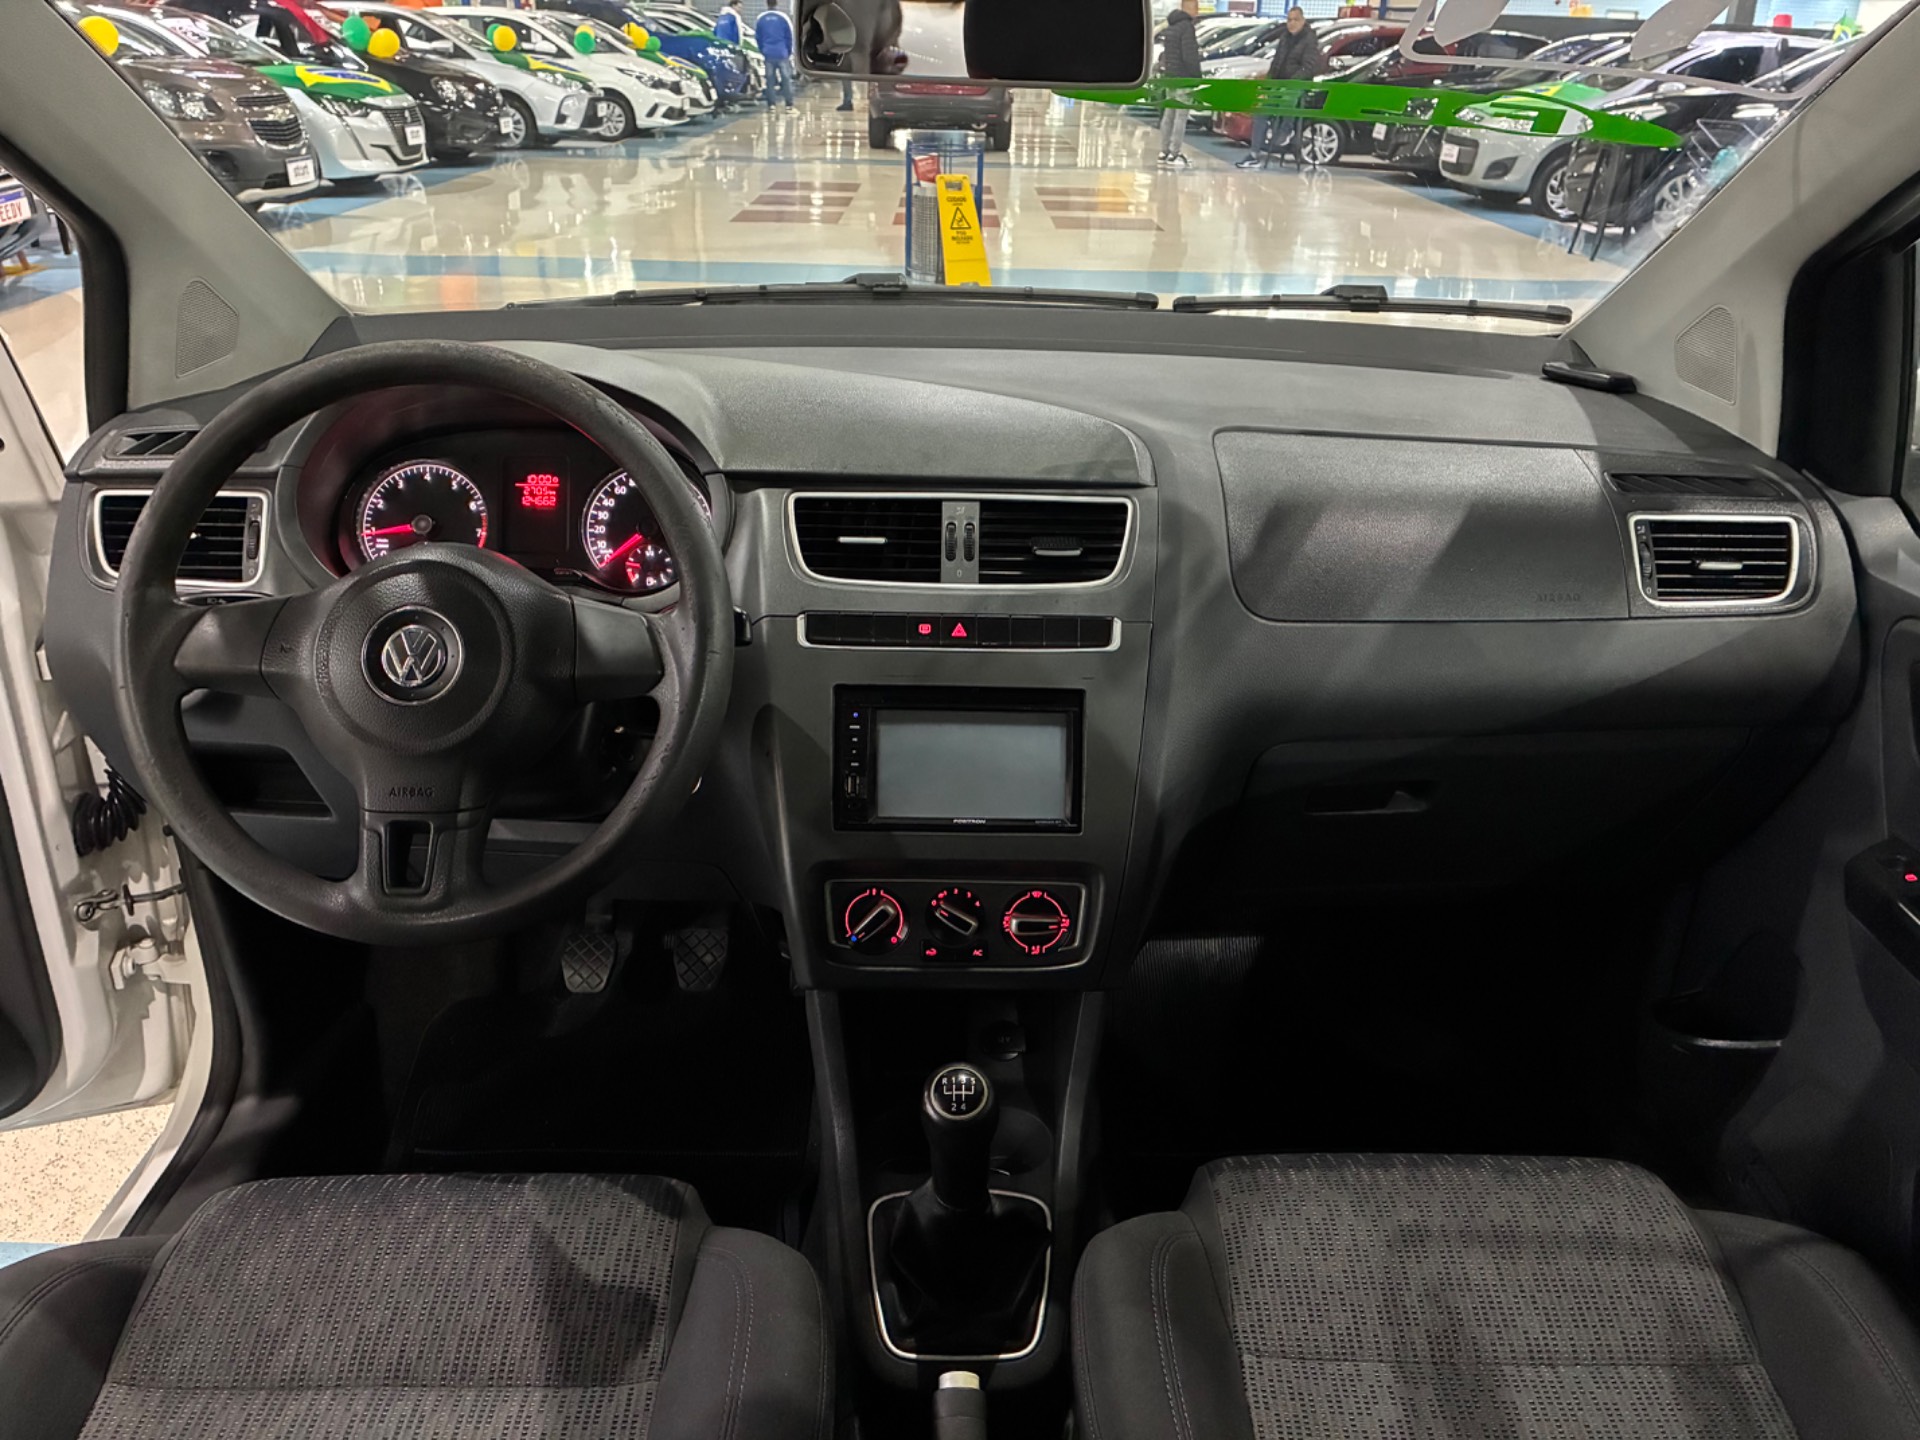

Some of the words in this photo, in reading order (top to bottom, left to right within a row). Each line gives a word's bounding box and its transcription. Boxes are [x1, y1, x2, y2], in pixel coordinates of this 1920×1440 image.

[397, 480, 404, 489] 3
[451, 481, 458, 490] 5
[614, 486, 627, 495] 60
[376, 500, 384, 509] 2
[469, 501, 477, 511] 6
[602, 498, 615, 507] 40
[597, 511, 609, 521] 30
[594, 525, 605, 534] 20
[597, 541, 607, 549] 10
[389, 786, 433, 798] AIRBAG
